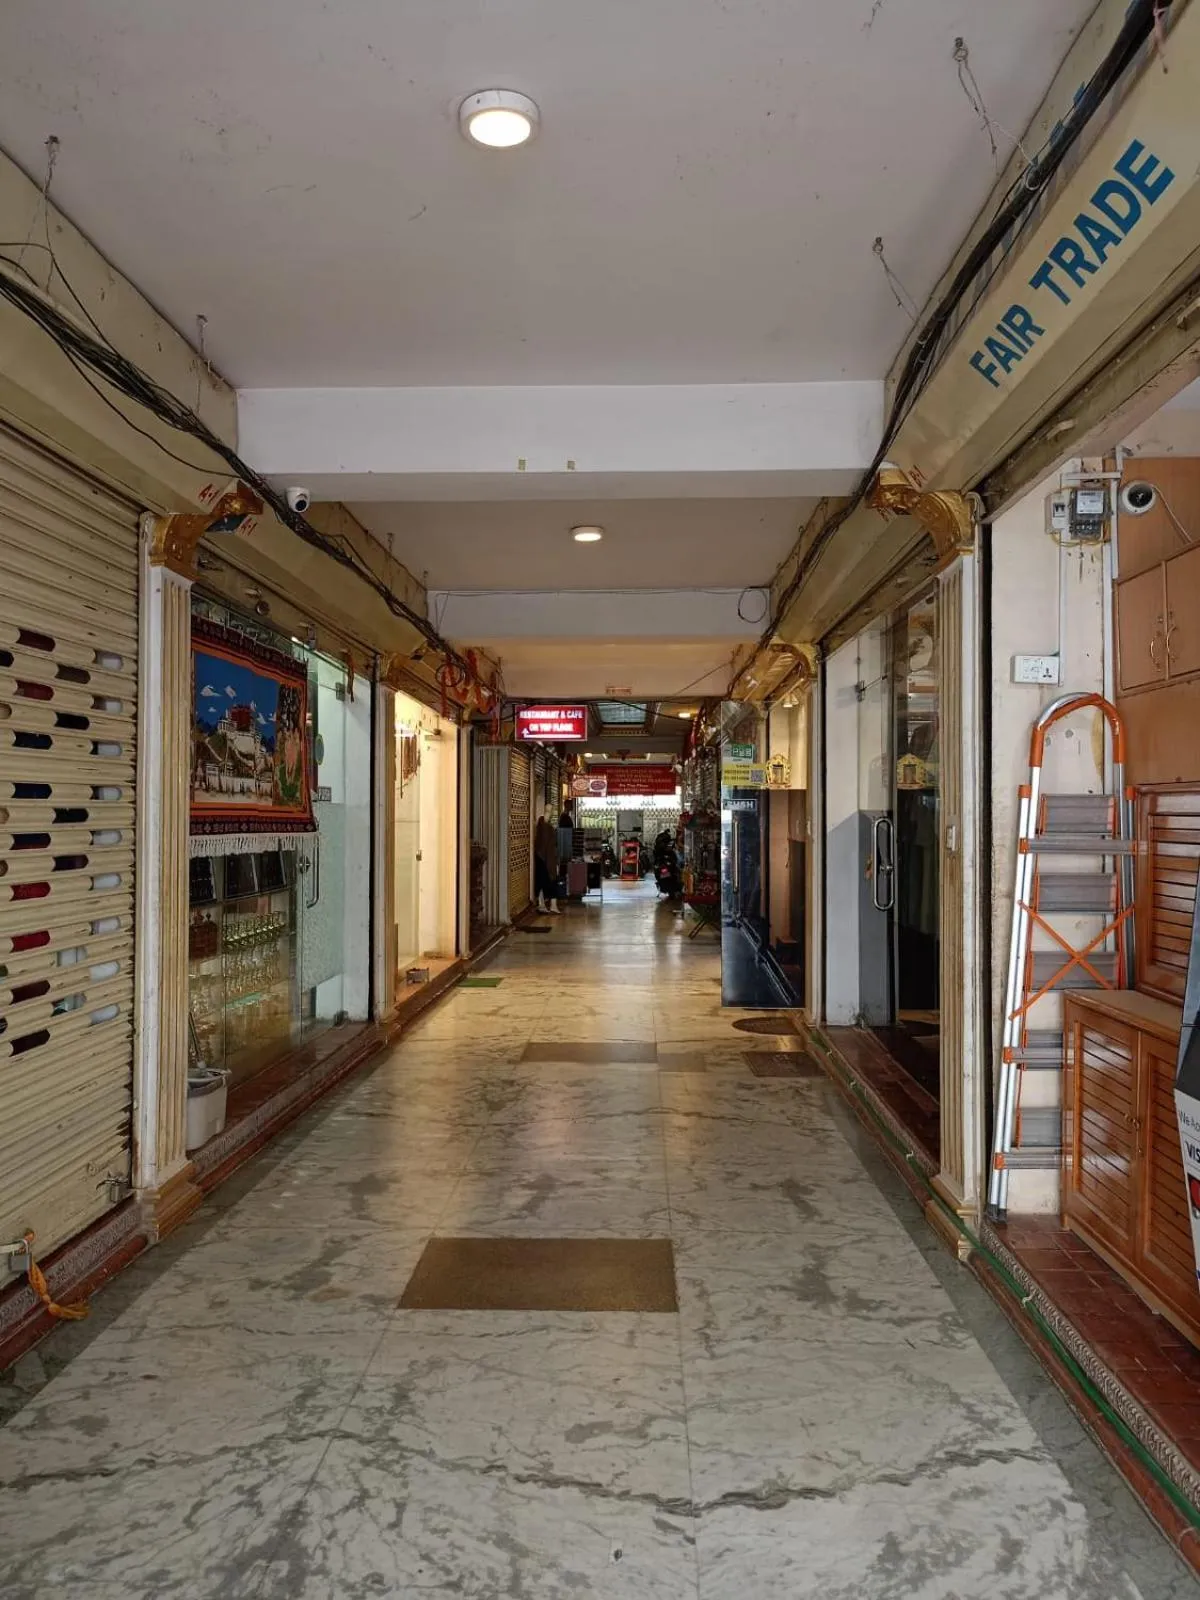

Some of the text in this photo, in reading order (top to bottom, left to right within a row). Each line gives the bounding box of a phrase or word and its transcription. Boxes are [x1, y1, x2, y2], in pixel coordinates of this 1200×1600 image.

[969, 138, 1175, 388] FAIR TRADE
[519, 710, 560, 719] RESTAURANT
[566, 710, 583, 719] CAFE
[553, 723, 574, 732] FLOOR
